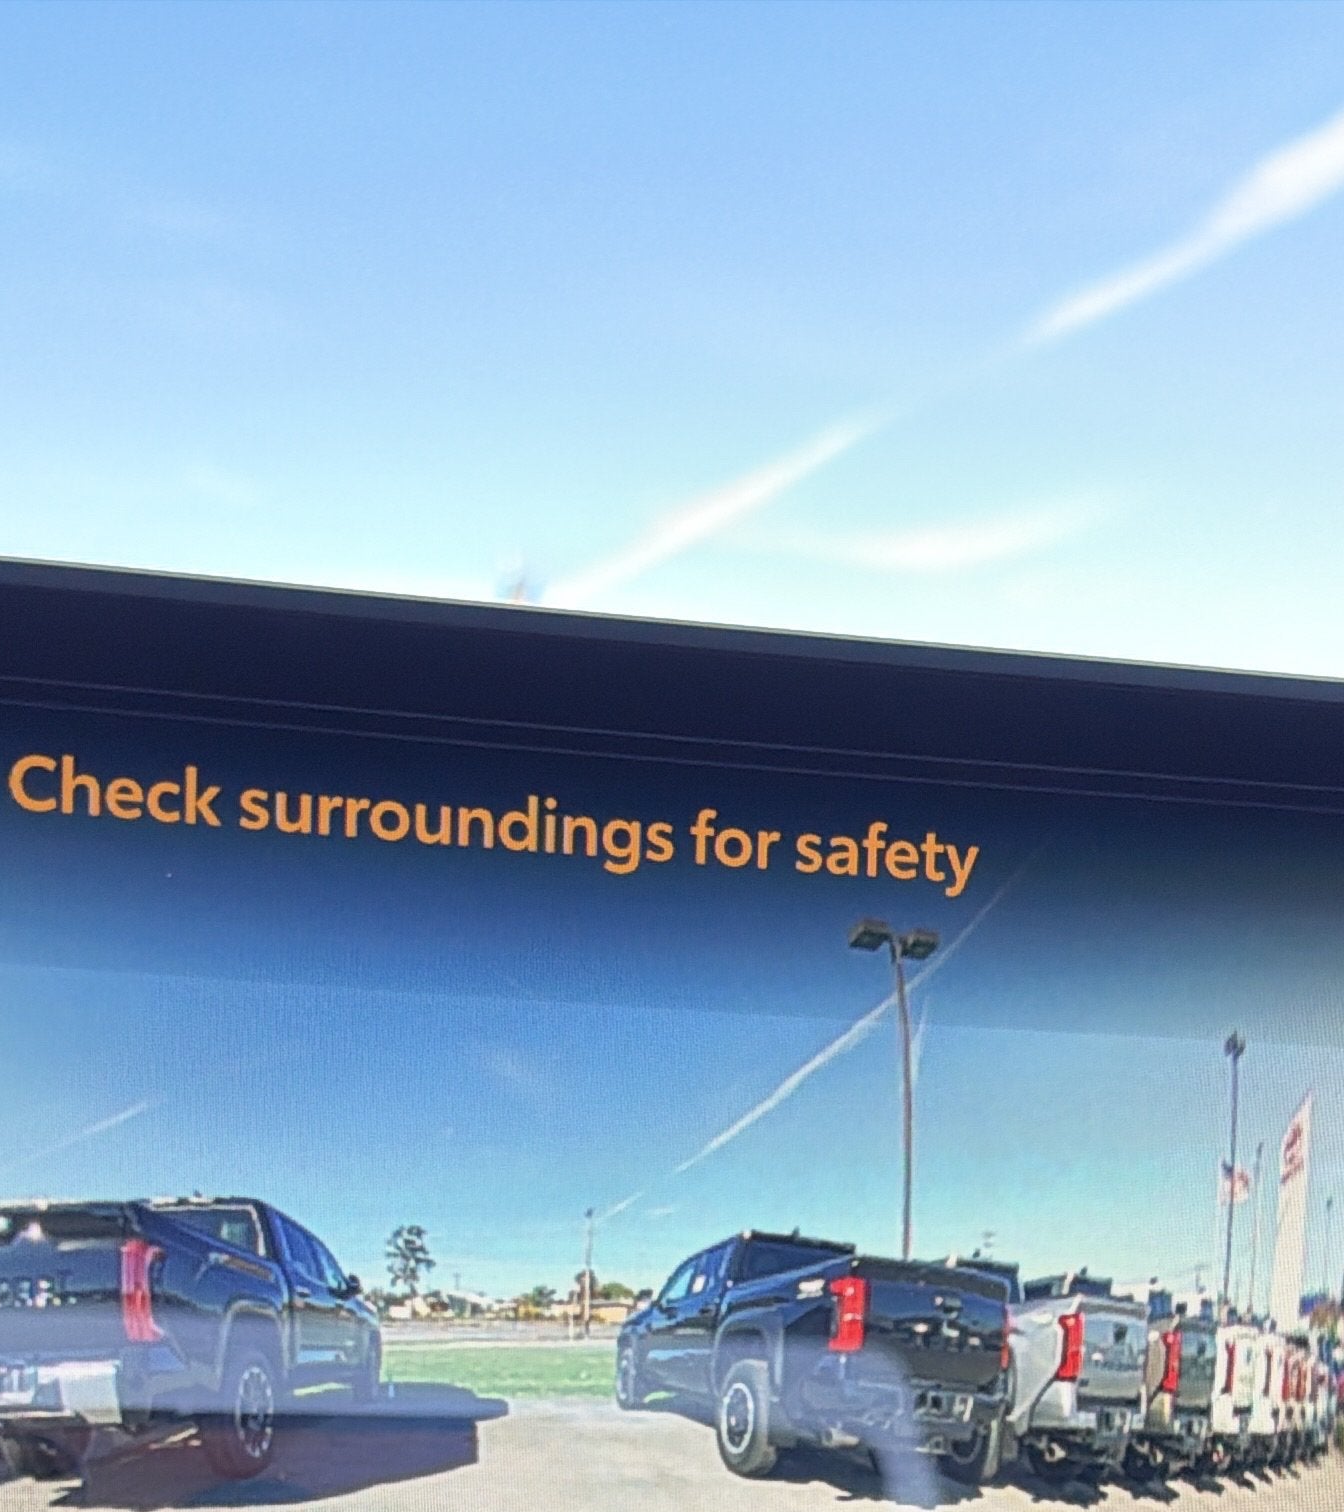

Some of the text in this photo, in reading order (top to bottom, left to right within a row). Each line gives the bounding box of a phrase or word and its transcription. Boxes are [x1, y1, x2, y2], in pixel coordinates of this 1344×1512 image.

[8, 754, 980, 898] Check surroundings for safety
